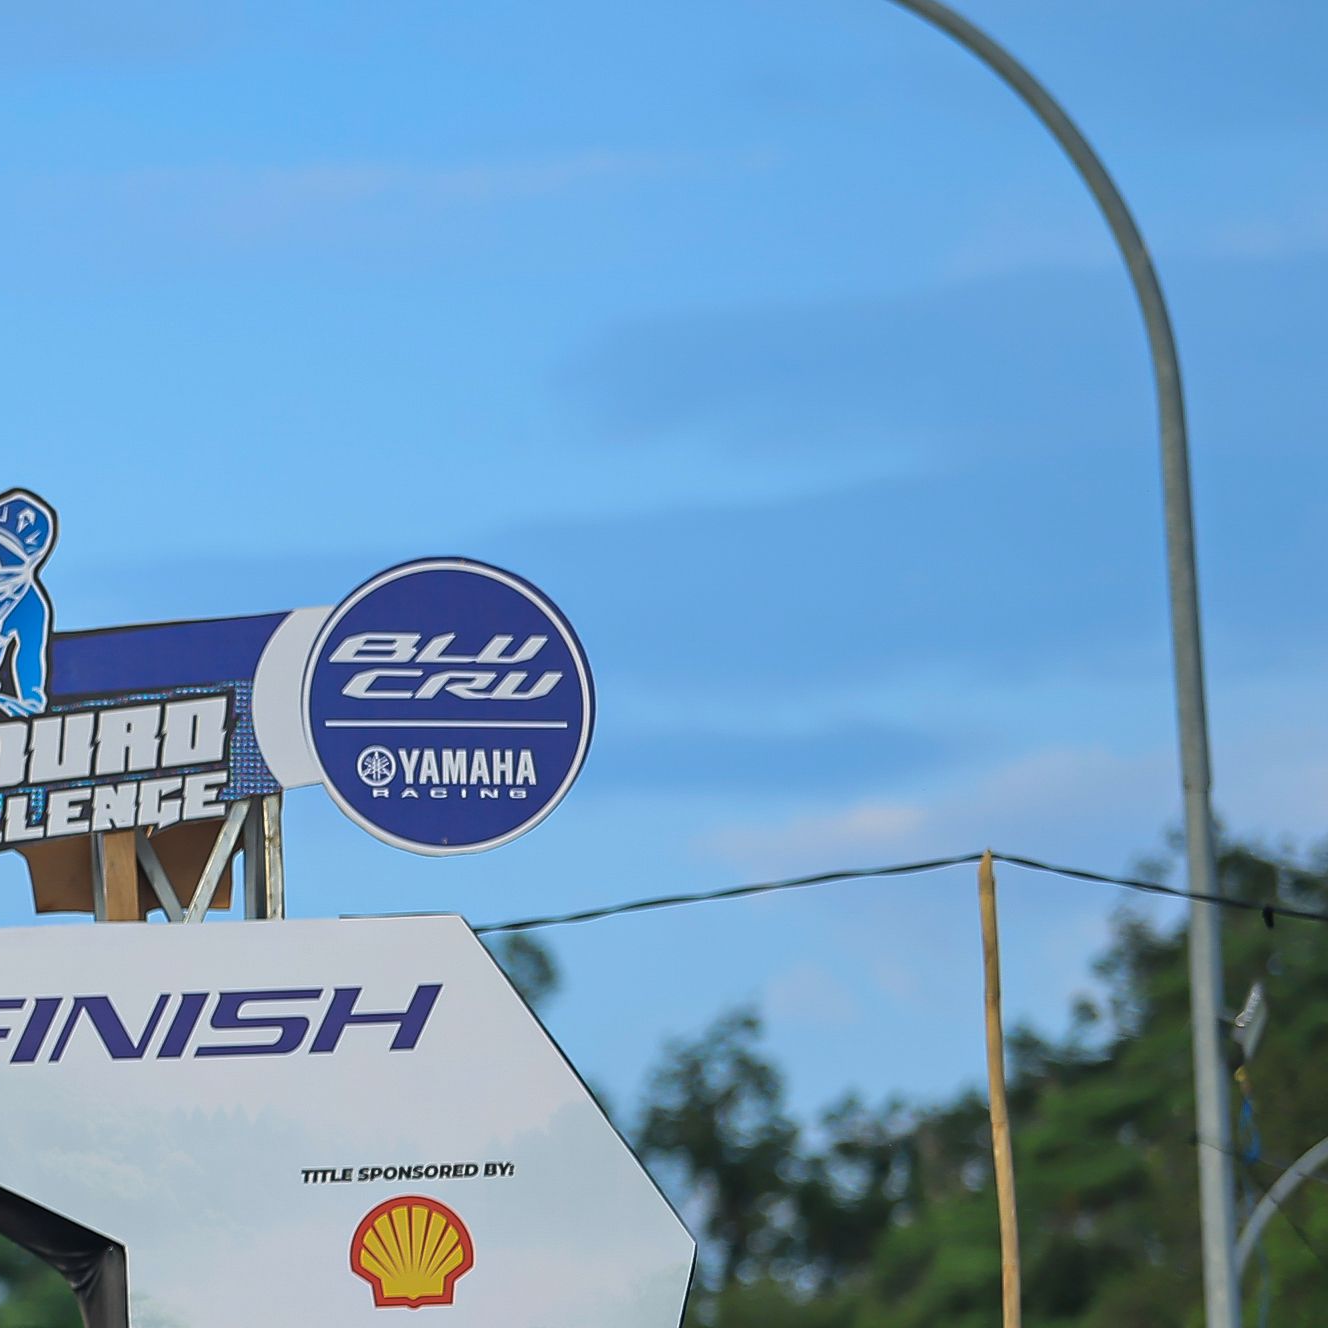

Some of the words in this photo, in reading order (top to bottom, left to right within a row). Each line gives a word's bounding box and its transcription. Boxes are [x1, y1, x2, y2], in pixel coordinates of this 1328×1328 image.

[329, 632, 548, 664] BLU
[341, 668, 563, 700] CRU
[397, 747, 538, 786] YAMAHA
[372, 787, 528, 800] RACING
[301, 1168, 353, 1184] TITLE
[357, 1164, 479, 1182] SPONSORED
[484, 1161, 516, 1177] BY:
